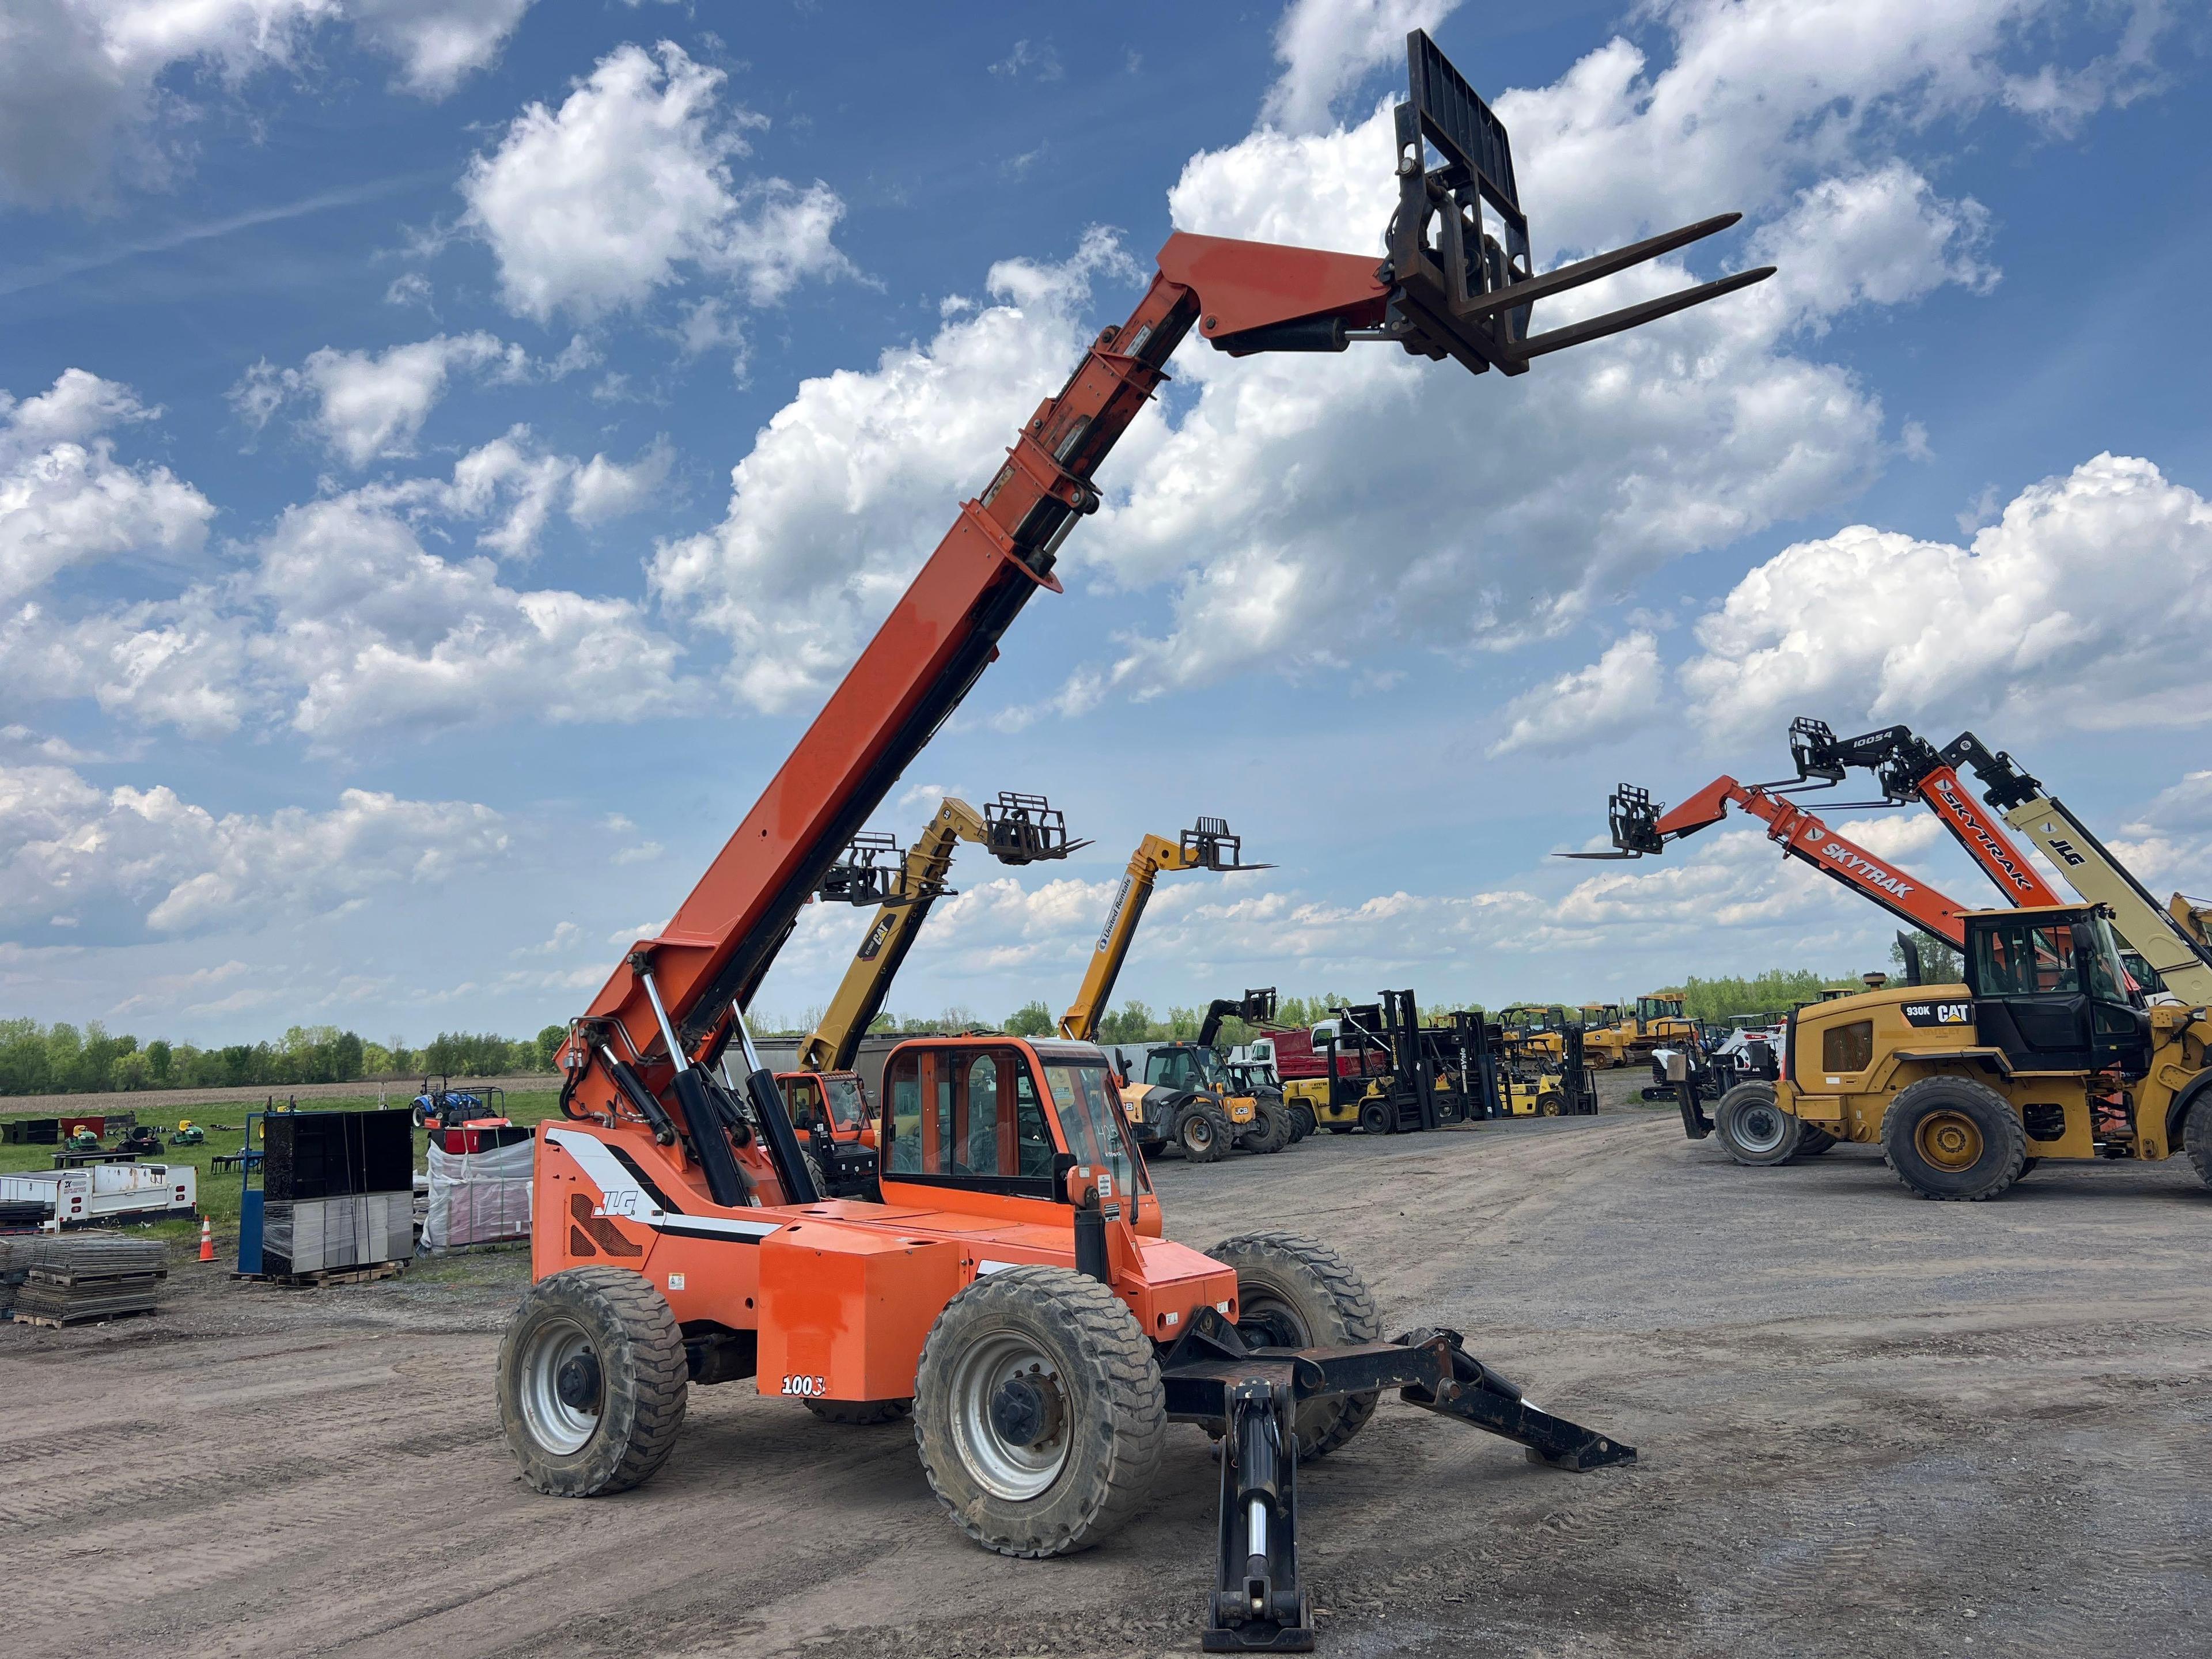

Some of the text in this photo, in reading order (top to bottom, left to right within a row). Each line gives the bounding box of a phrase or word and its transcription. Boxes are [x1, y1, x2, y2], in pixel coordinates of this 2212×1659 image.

[1853, 731, 1893, 748] 10054
[1939, 791, 2033, 890] SKYTRAK
[2047, 839, 2086, 866] JLG
[1821, 843, 1915, 900] SKYTRAK
[1104, 878, 1131, 938] United Rentals
[873, 921, 889, 945] CAT
[1906, 1004, 1968, 1022] 930K CAT
[1096, 1124, 1118, 1141] 425
